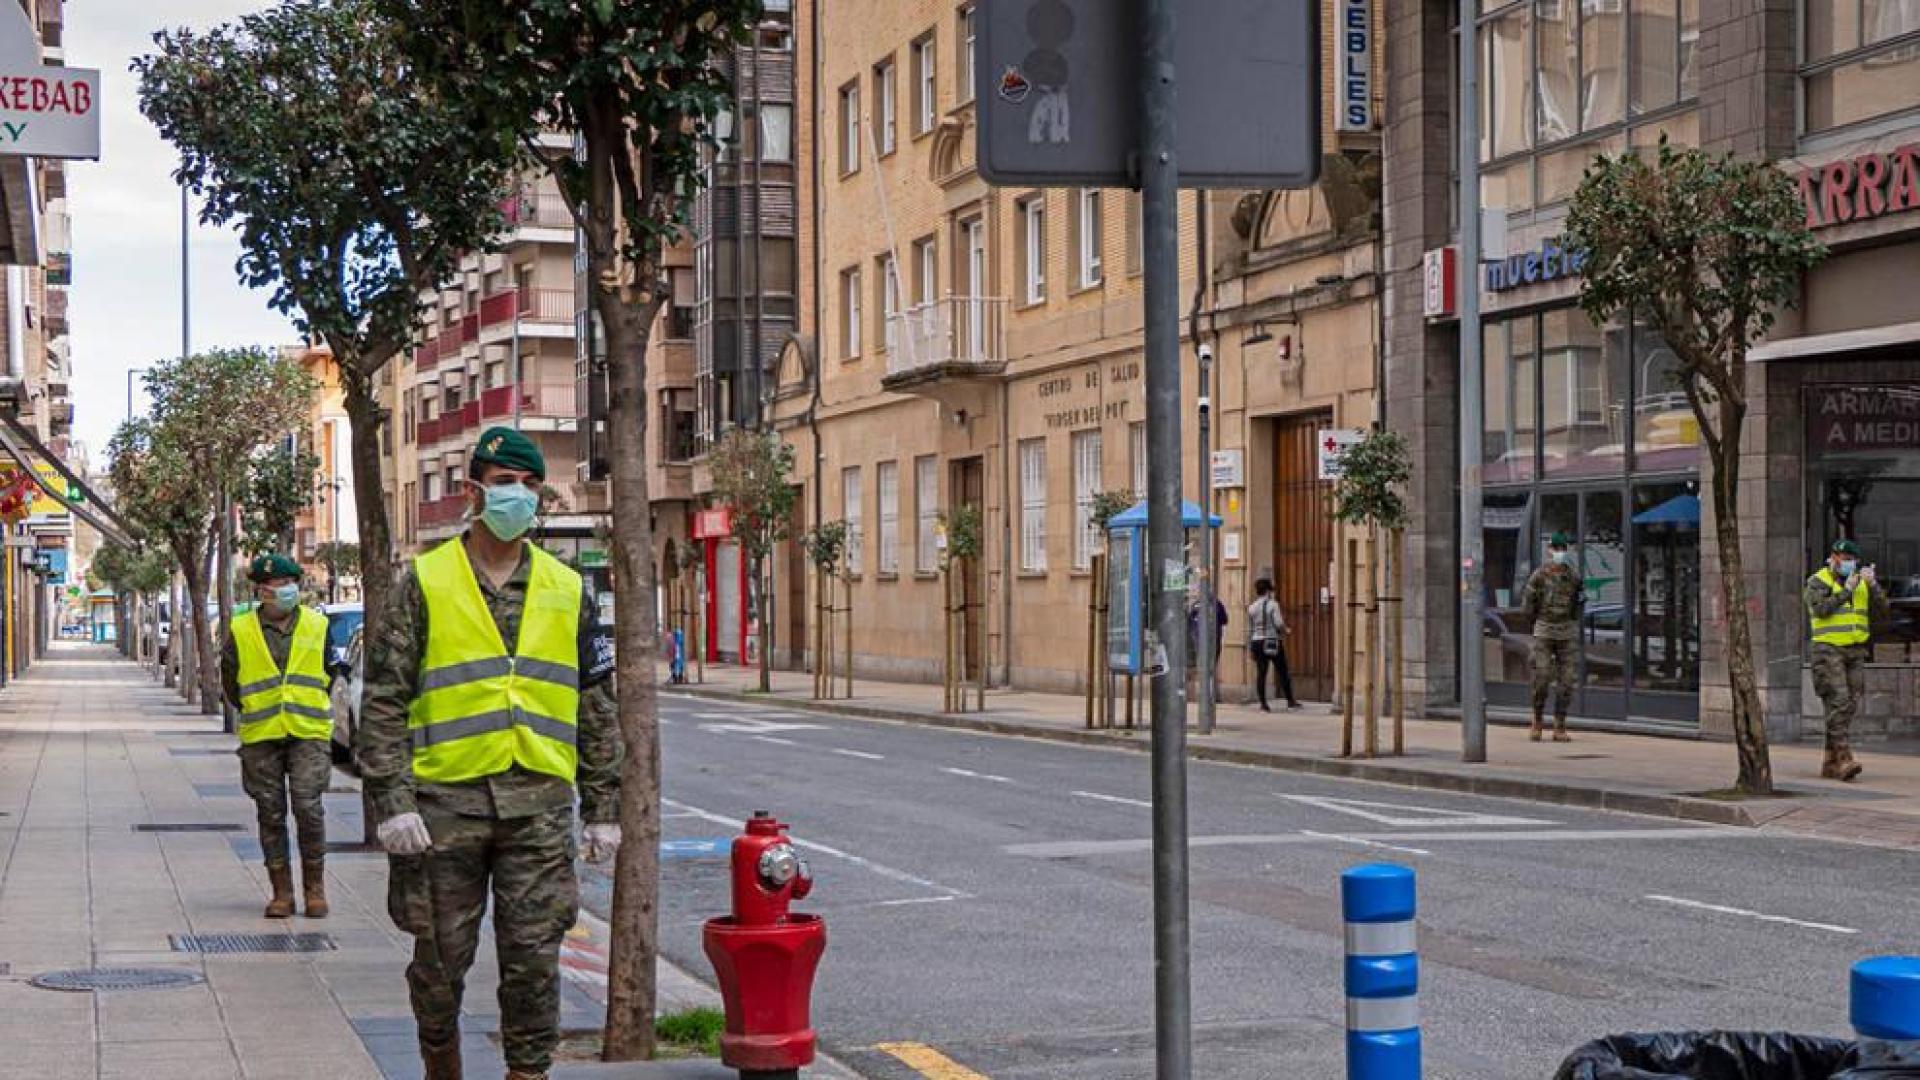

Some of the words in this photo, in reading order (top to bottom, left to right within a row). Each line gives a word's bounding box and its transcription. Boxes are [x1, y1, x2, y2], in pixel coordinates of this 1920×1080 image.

[1347, 0, 1366, 125] EBLES
[1827, 421, 1847, 443] A
[1854, 421, 1919, 443] MEDI
